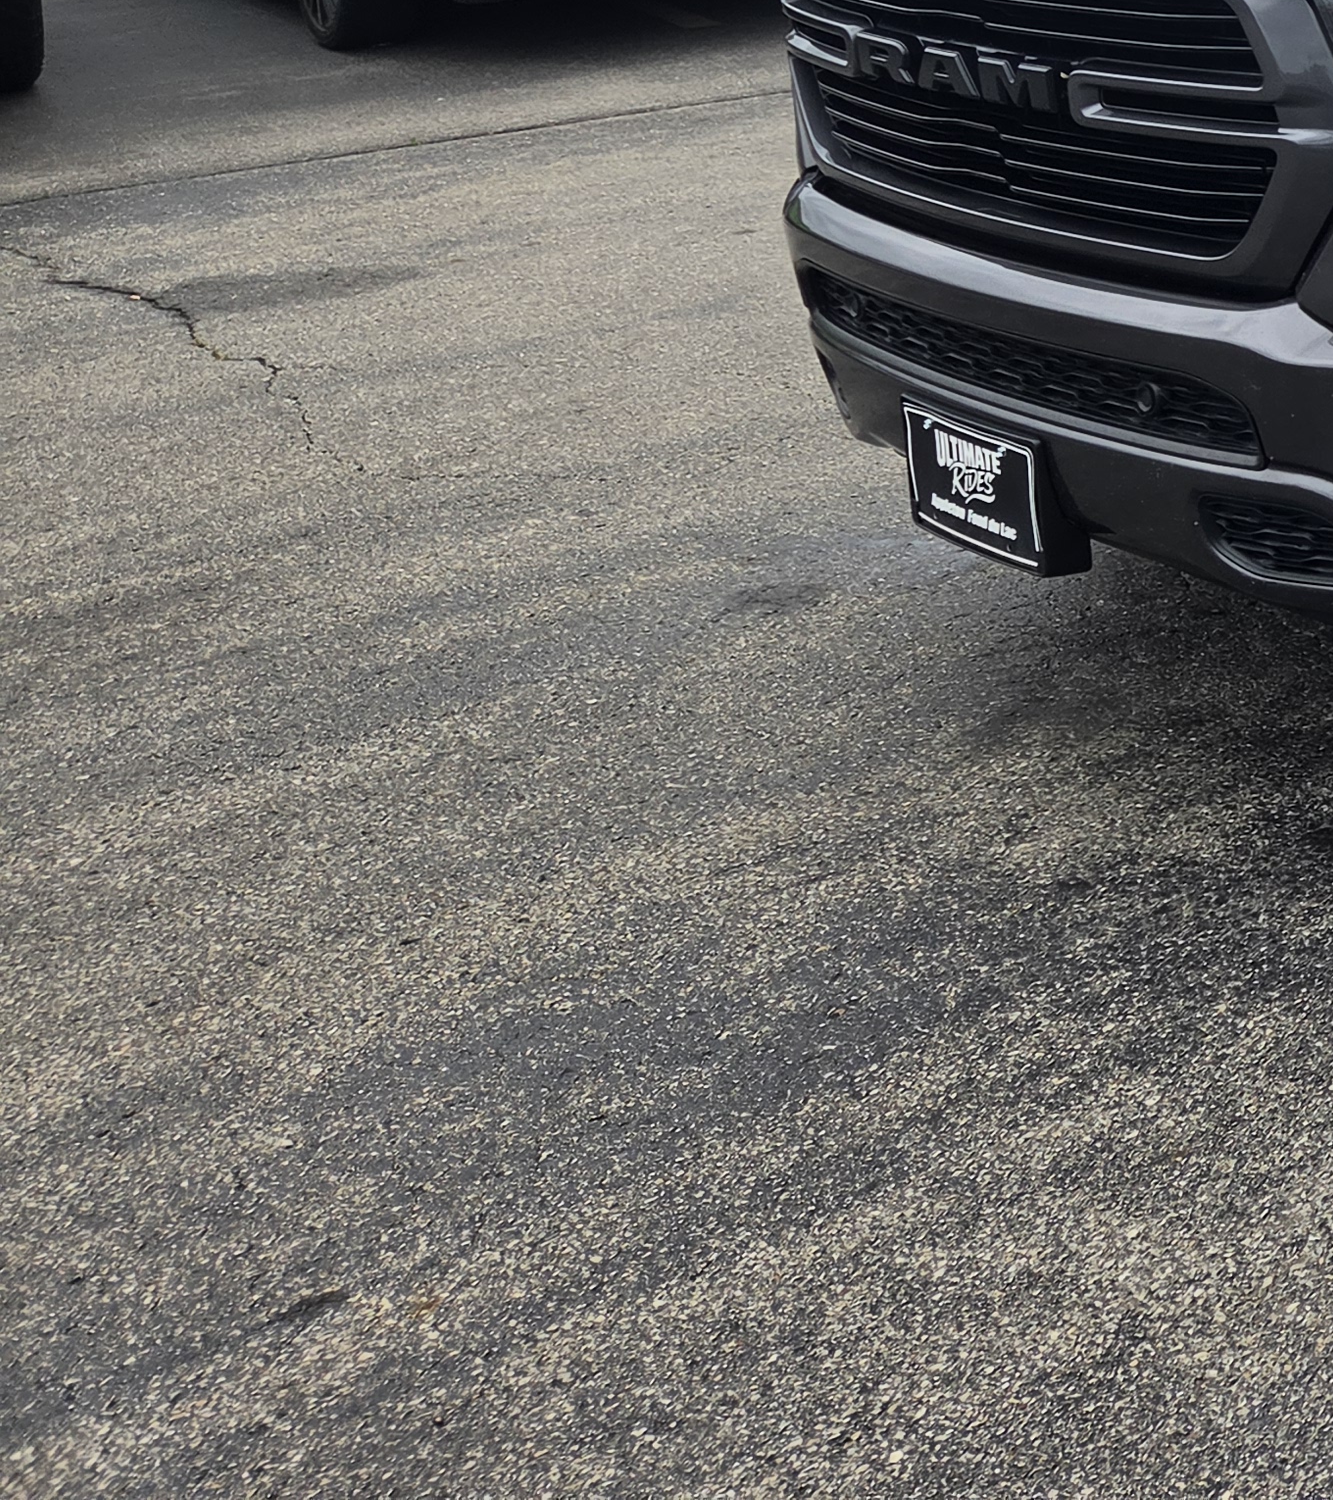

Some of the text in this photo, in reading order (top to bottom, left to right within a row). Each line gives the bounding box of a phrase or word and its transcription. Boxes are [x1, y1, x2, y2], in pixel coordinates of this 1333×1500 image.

[856, 30, 1056, 114] RAM
[934, 428, 1002, 475] ULTIMATE
[949, 461, 997, 505] RIDES
